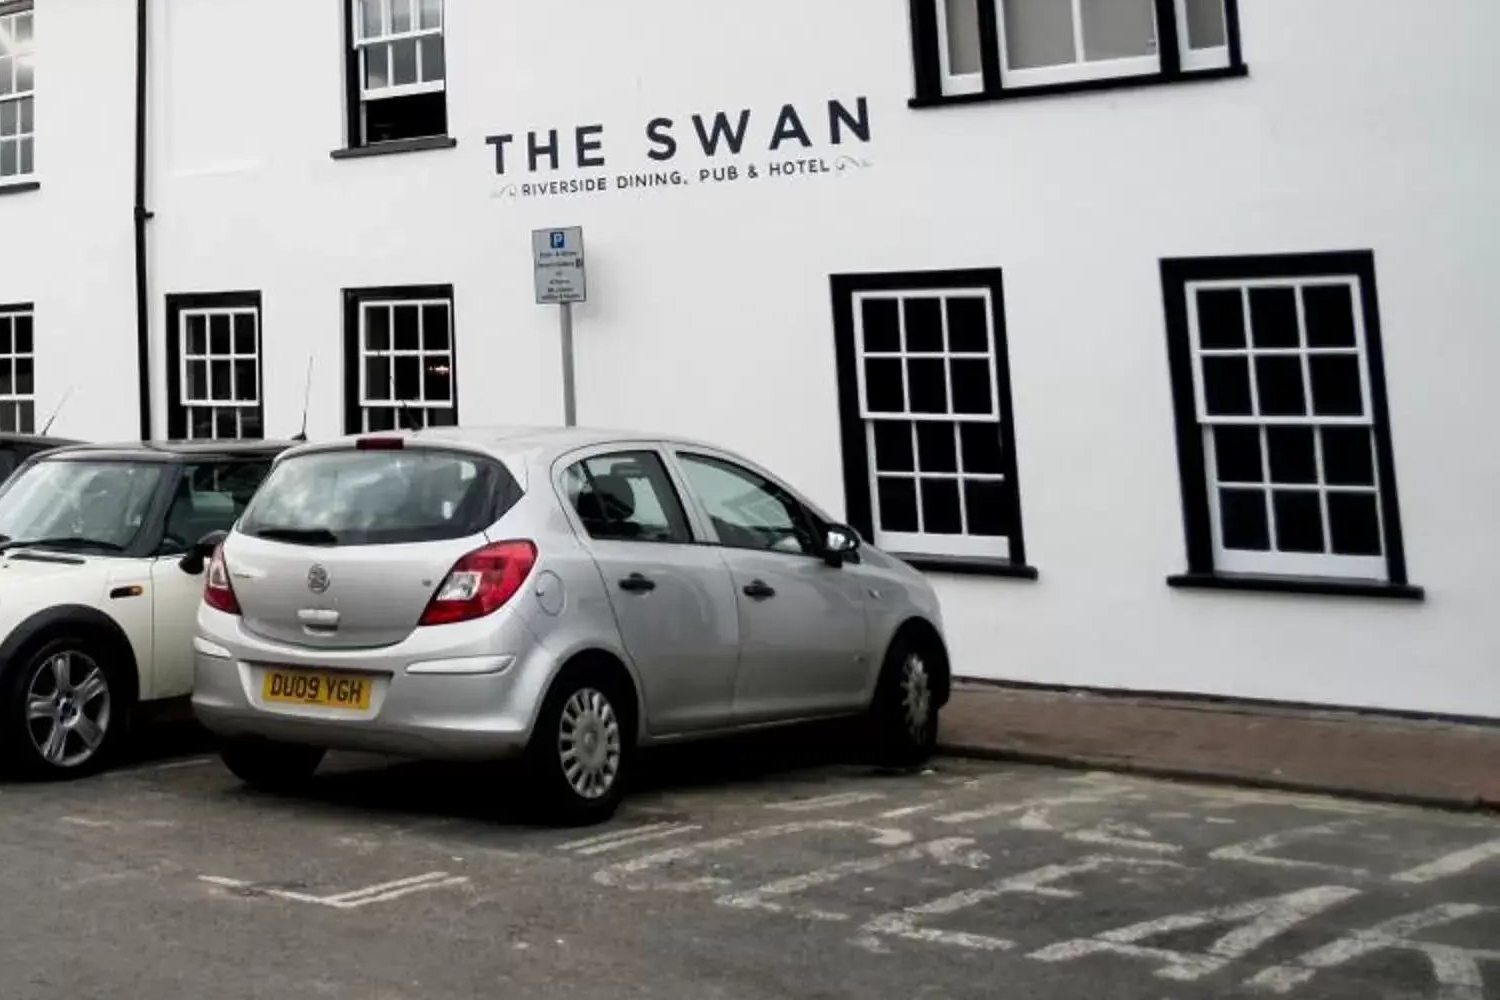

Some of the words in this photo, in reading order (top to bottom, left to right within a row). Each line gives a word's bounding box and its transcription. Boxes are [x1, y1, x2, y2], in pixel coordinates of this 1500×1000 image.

[485, 124, 605, 175] THE
[646, 96, 871, 161] SWAN
[522, 176, 607, 197] RIVERSIDE
[699, 166, 739, 183] PUB
[747, 164, 759, 179] &
[768, 159, 830, 177] HOTEL
[270, 673, 320, 700] DU09
[322, 675, 363, 705] YGH
